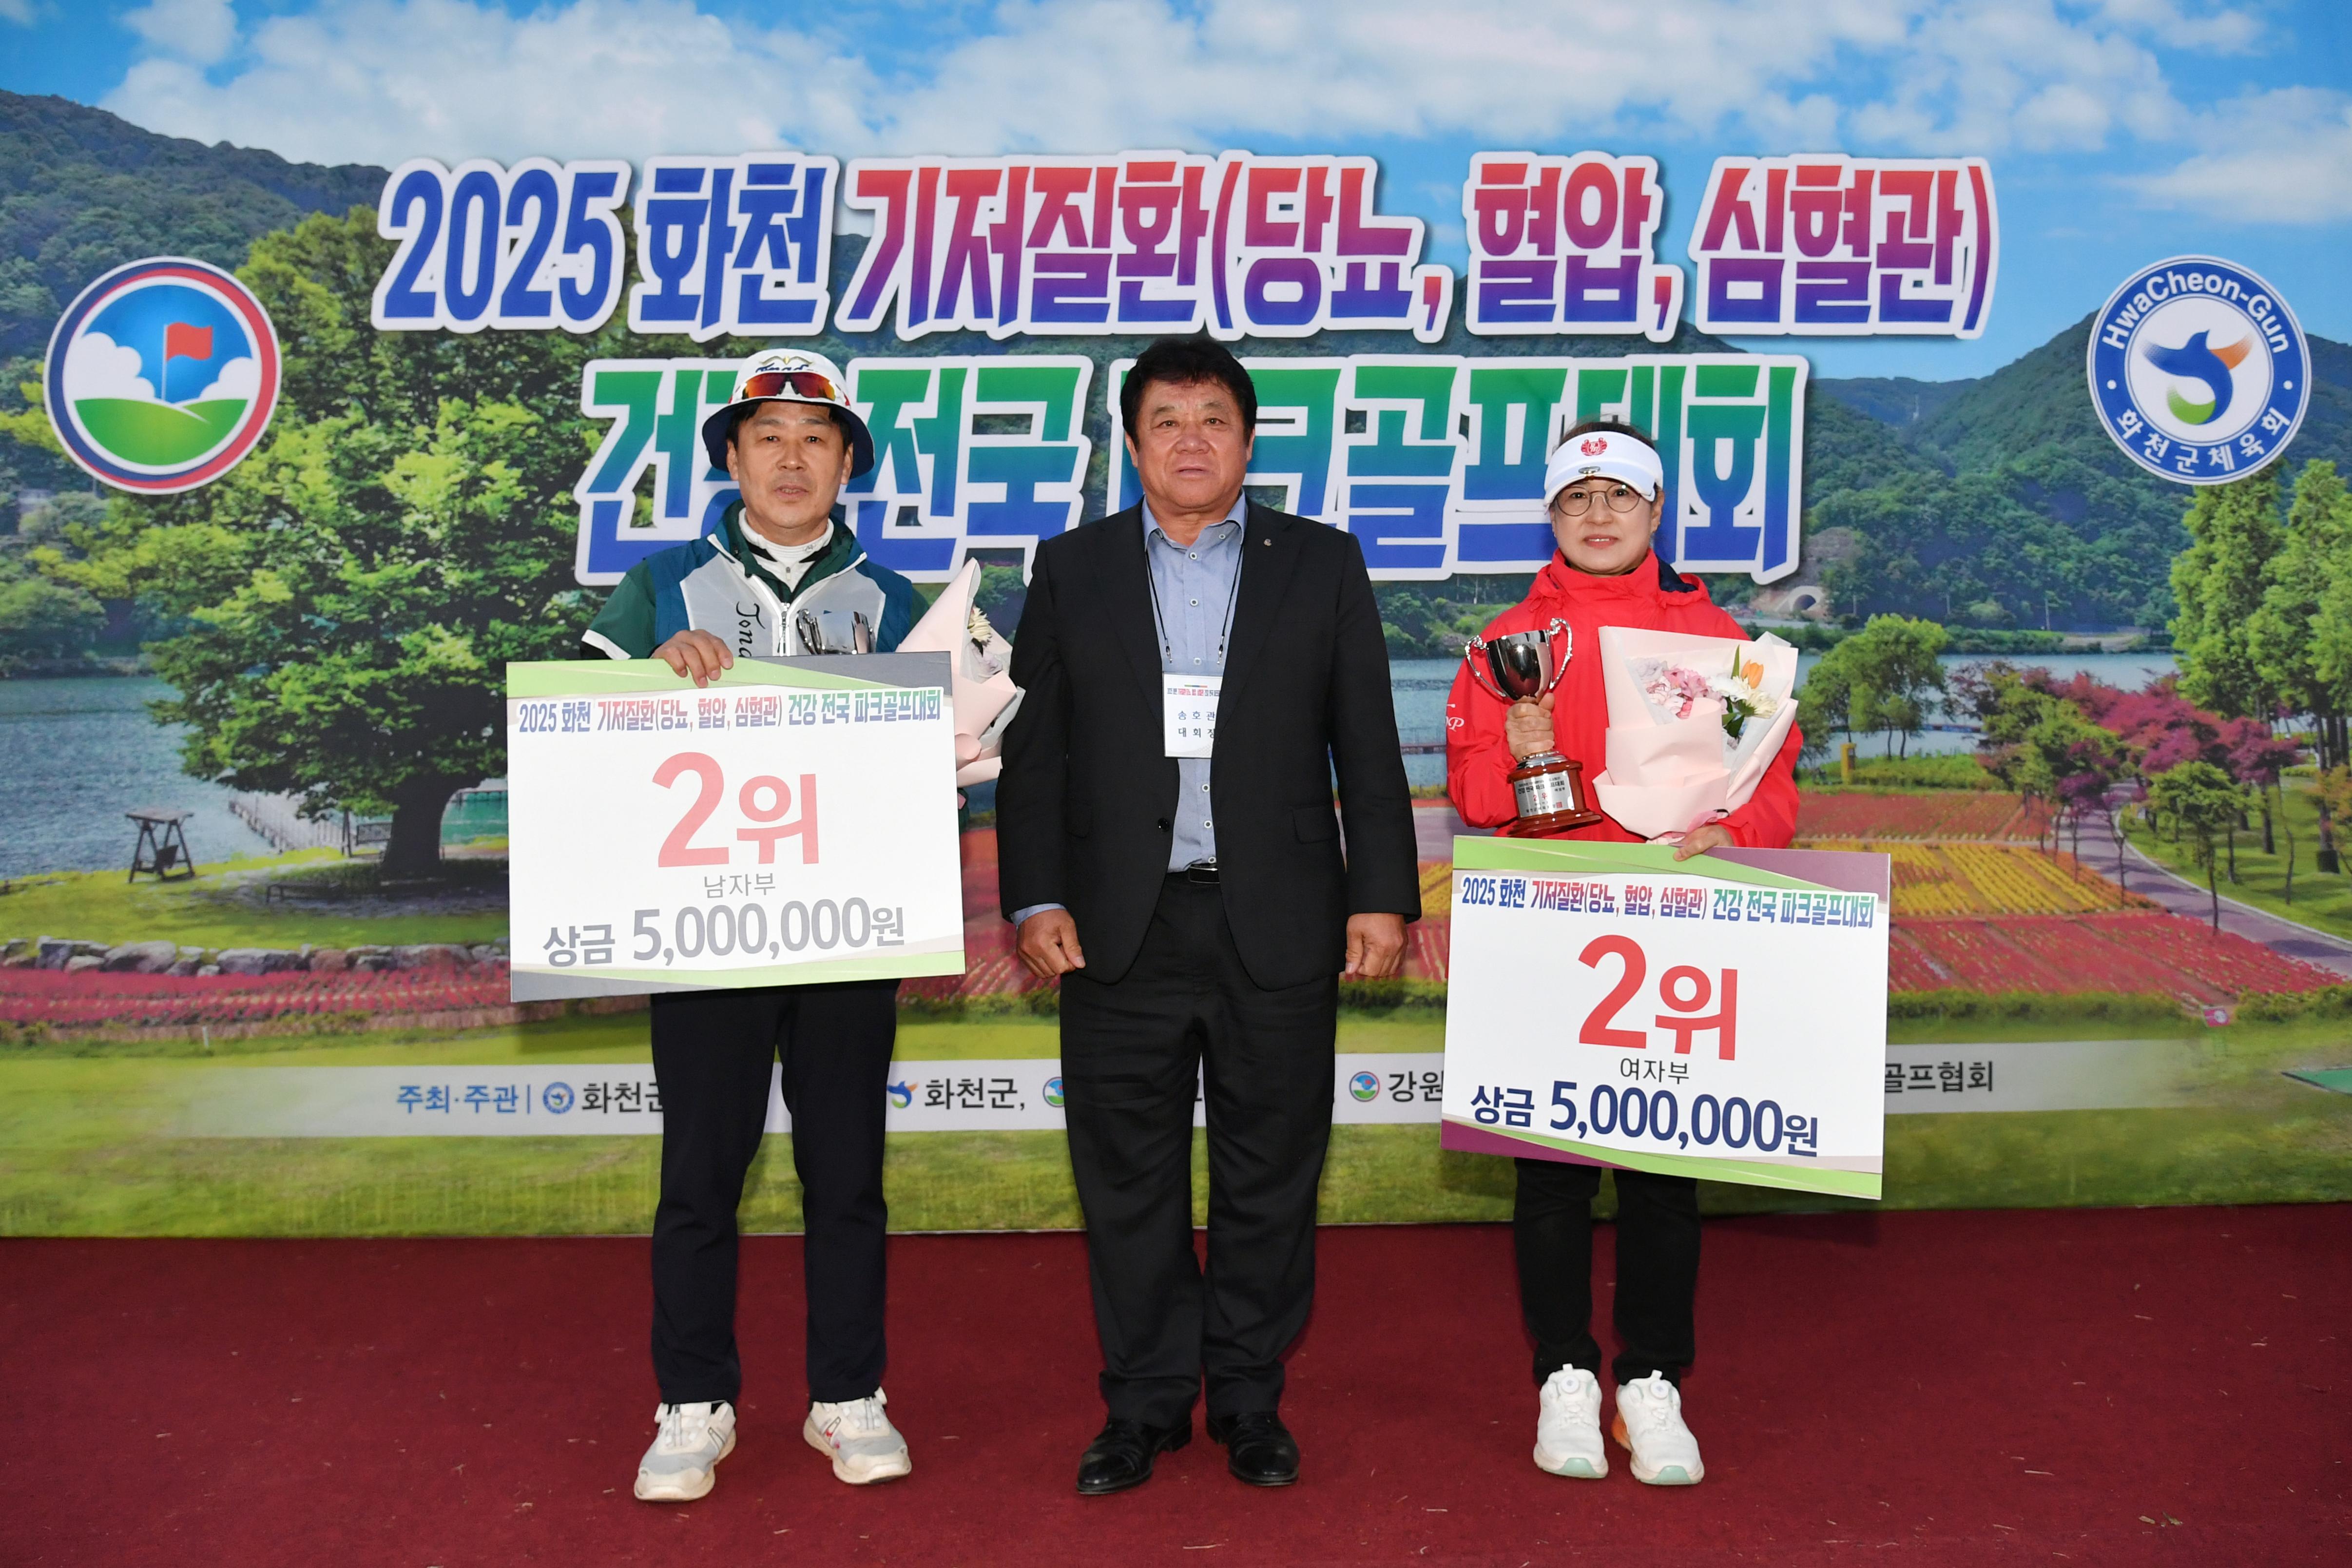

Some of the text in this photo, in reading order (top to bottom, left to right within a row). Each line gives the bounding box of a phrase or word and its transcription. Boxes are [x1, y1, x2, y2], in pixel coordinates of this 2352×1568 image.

[384, 160, 1990, 331] 2025 화천 기저질환(당뇨, 혈압, 심혈관)
[2102, 271, 2289, 354] HwaCheon-Gun
[2117, 407, 2291, 474] 화천군체육회
[519, 689, 941, 733] 2025 화천 기저질환(당뇨, 혈압, 심혈관) 건강 전국 파크골프대회
[1446, 716, 1465, 732] P
[652, 752, 819, 868] 2위
[703, 872, 776, 899] 남자부
[1462, 877, 1875, 929] 2025 화천 기저질환(당뇨, 혈압, 심혈관) 건강 전국 파크골프대회
[542, 896, 905, 968] 상금 5,000,000원
[1578, 934, 1738, 1061] 2위
[924, 1077, 1025, 1111] 화천군,
[1885, 1061, 1992, 1093] 골프협회
[1619, 1058, 1690, 1085] 여자부
[1470, 1080, 1818, 1158] 상금 5,000,000원
